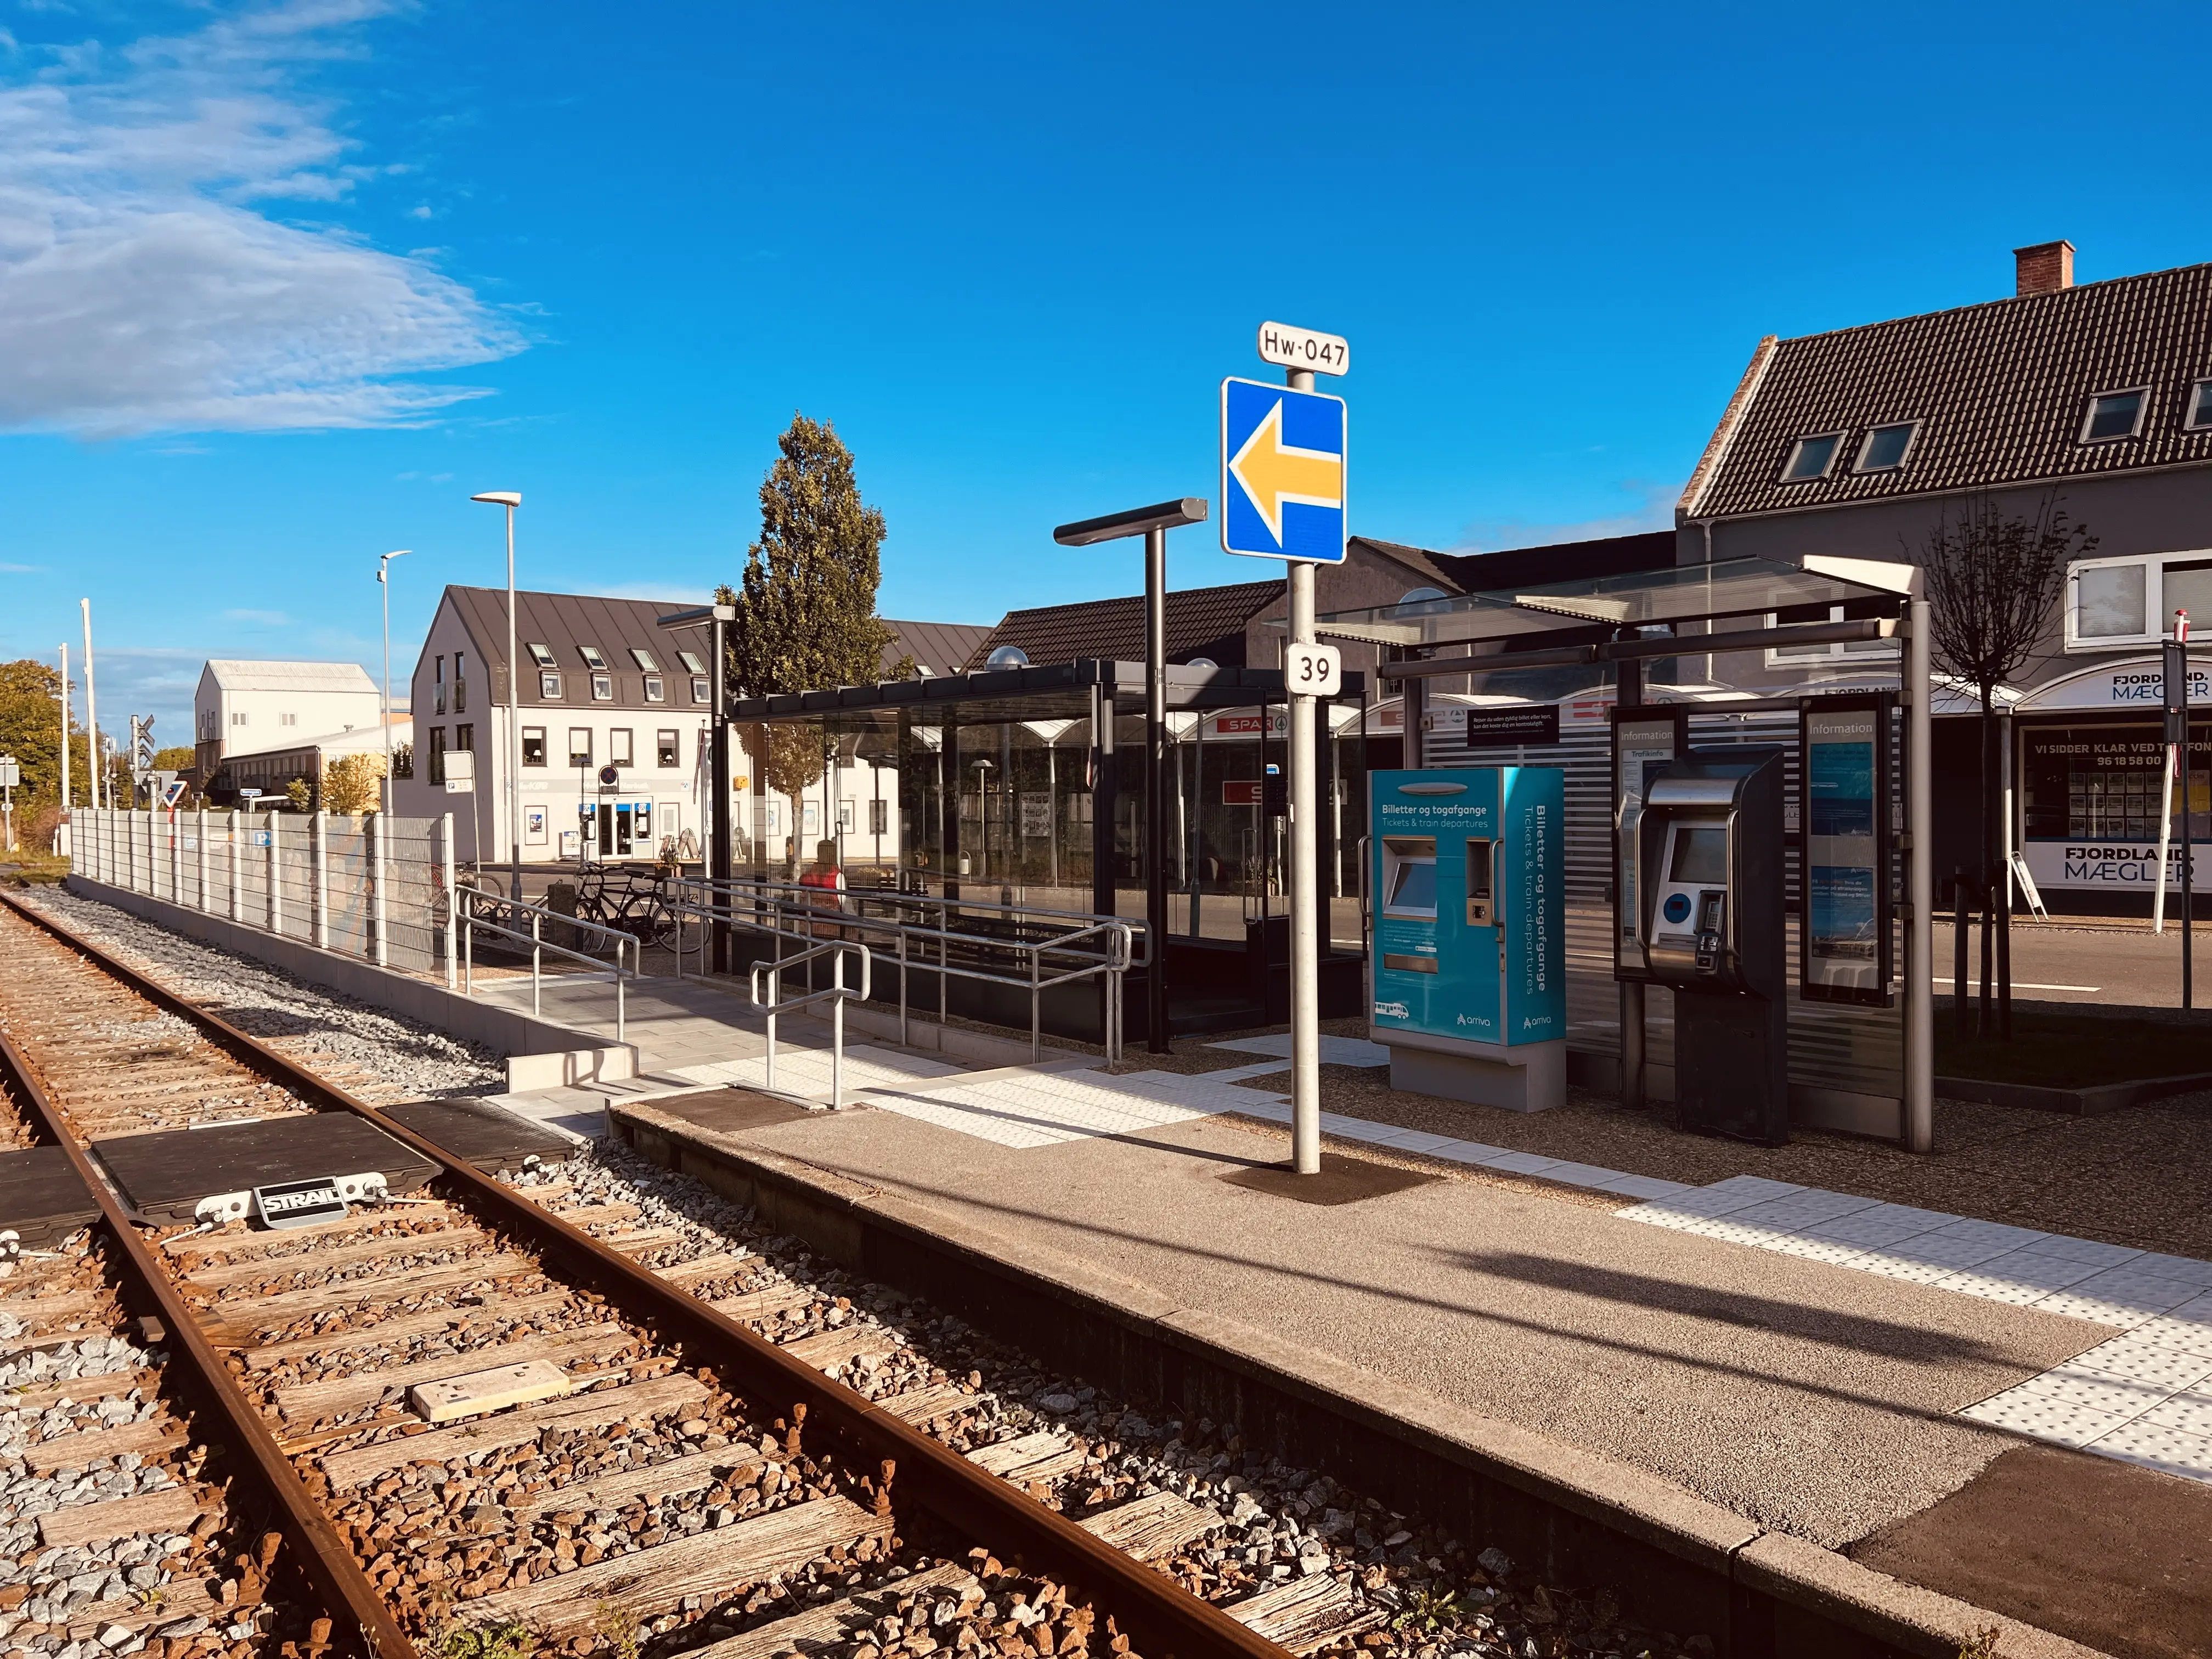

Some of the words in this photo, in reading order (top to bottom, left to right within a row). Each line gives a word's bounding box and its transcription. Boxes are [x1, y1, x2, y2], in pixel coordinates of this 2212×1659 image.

[1300, 656, 1329, 683] 39
[2113, 672, 2209, 685] FJORDND.
[2113, 682, 2209, 700] MÆGER
[1810, 723, 1873, 735] Information
[1621, 730, 1673, 741] Information
[2035, 745, 2047, 754] VI
[2049, 744, 2089, 753] SIDDER
[2094, 744, 2126, 753] KLAR
[2130, 743, 2155, 752] VED
[2097, 757, 2112, 765] 96
[2114, 757, 2126, 765] 18
[2129, 757, 2143, 765] 58
[2146, 756, 2161, 765] 00
[1382, 804, 1417, 814] Billetter
[1419, 807, 1430, 816] og
[1432, 804, 1487, 816] togafgange
[1382, 817, 1409, 827] Tickets
[1411, 819, 1417, 827] &
[1419, 819, 1438, 827] train
[1441, 819, 1488, 829] departures
[1525, 805, 1533, 856] Tickets
[257, 833, 267, 845] P
[1537, 805, 1545, 870] Billetter
[1525, 861, 1533, 870] &
[1536, 874, 1544, 893] og
[1536, 898, 1547, 991] togafgange
[1525, 914, 1533, 995] departures
[1466, 1017, 1491, 1026] arriva
[1532, 1016, 1551, 1025] arriva
[263, 1188, 340, 1211] STRAIL
